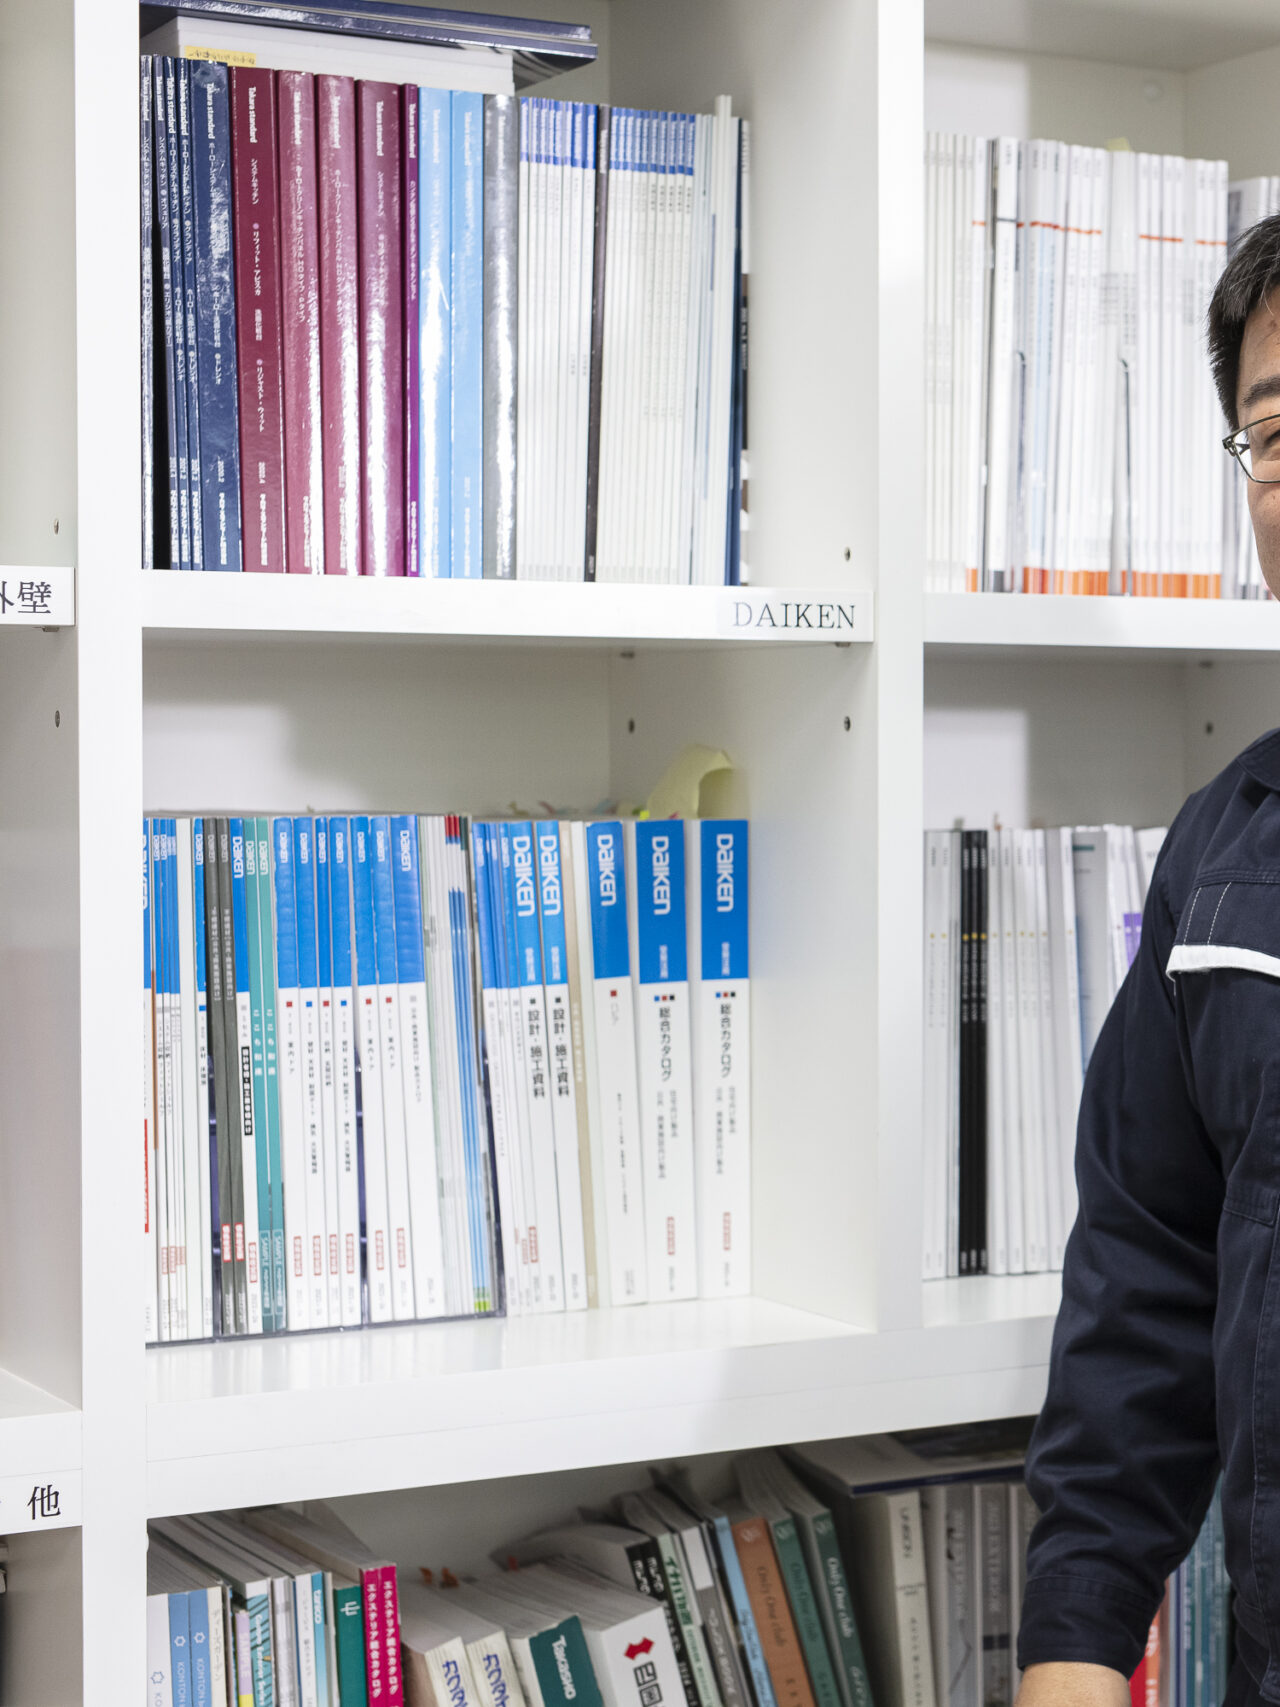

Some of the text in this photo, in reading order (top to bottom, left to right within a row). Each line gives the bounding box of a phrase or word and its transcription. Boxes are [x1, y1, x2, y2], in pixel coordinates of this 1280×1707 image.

[207, 82, 216, 139] Takara standard
[248, 87, 258, 143] Takara standard
[376, 100, 385, 157] Takara standard
[409, 103, 417, 158] Takara standard
[733, 601, 856, 629] DAIKEN
[195, 834, 203, 865] DAIKEN
[232, 836, 243, 878] DAIKEN
[246, 840, 255, 875] DAIKEN
[259, 840, 268, 875] DAIKEN
[280, 831, 288, 863] DAIKEN
[300, 832, 308, 864] DAIKEN
[318, 832, 326, 863] DAIKEN
[335, 832, 343, 864] DAIKEN
[357, 831, 365, 863] DAIKEN
[376, 830, 385, 862] DAIKEN
[400, 830, 411, 872] DAIKEN
[597, 834, 617, 906] DAIKEN
[716, 834, 734, 912] DAIKEN
[512, 835, 535, 917] DAIKEN
[540, 835, 561, 915] DAIKEN
[652, 836, 671, 915] DAIKEN
[528, 1009, 545, 1098] 設計・施工資料
[553, 1008, 570, 1097] 設計・施工資料
[659, 1007, 672, 1082] 総合カタログ
[720, 1003, 732, 1078] 総合カタログ
[27, 1485, 61, 1520] 他
[367, 1583, 381, 1698] エクステリア総合カタログ
[383, 1581, 398, 1695] エクステリア総合カタログ
